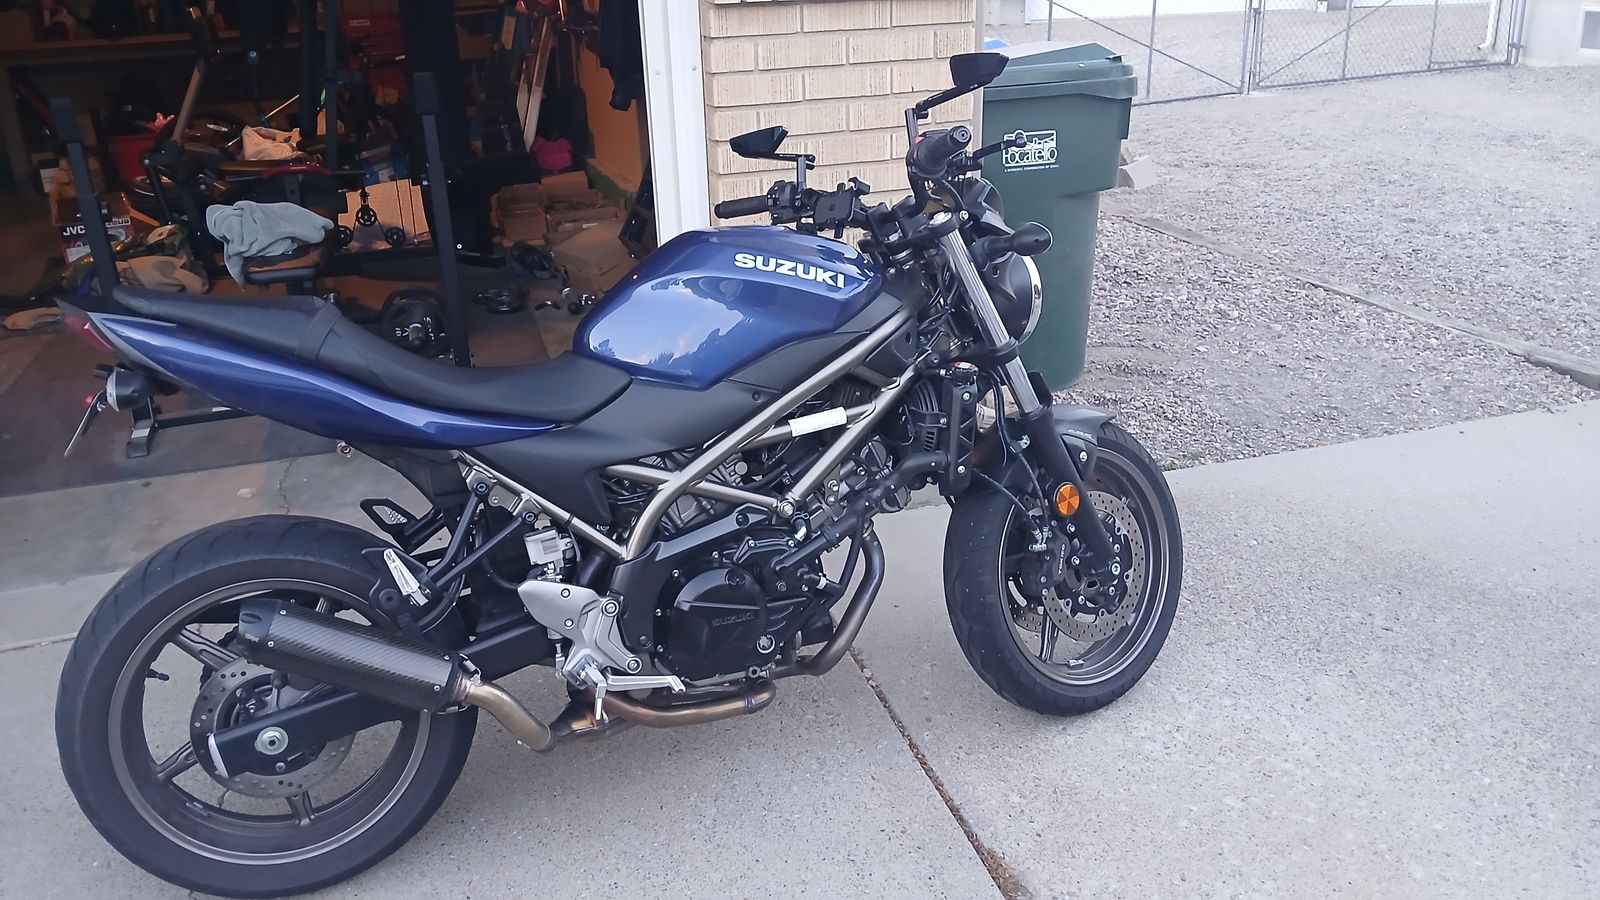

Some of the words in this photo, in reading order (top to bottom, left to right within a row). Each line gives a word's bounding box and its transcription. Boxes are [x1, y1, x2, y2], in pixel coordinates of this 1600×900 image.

[63, 225, 86, 236] JVC
[734, 253, 845, 288] SUZUKI
[712, 611, 755, 627] SUZUKI
